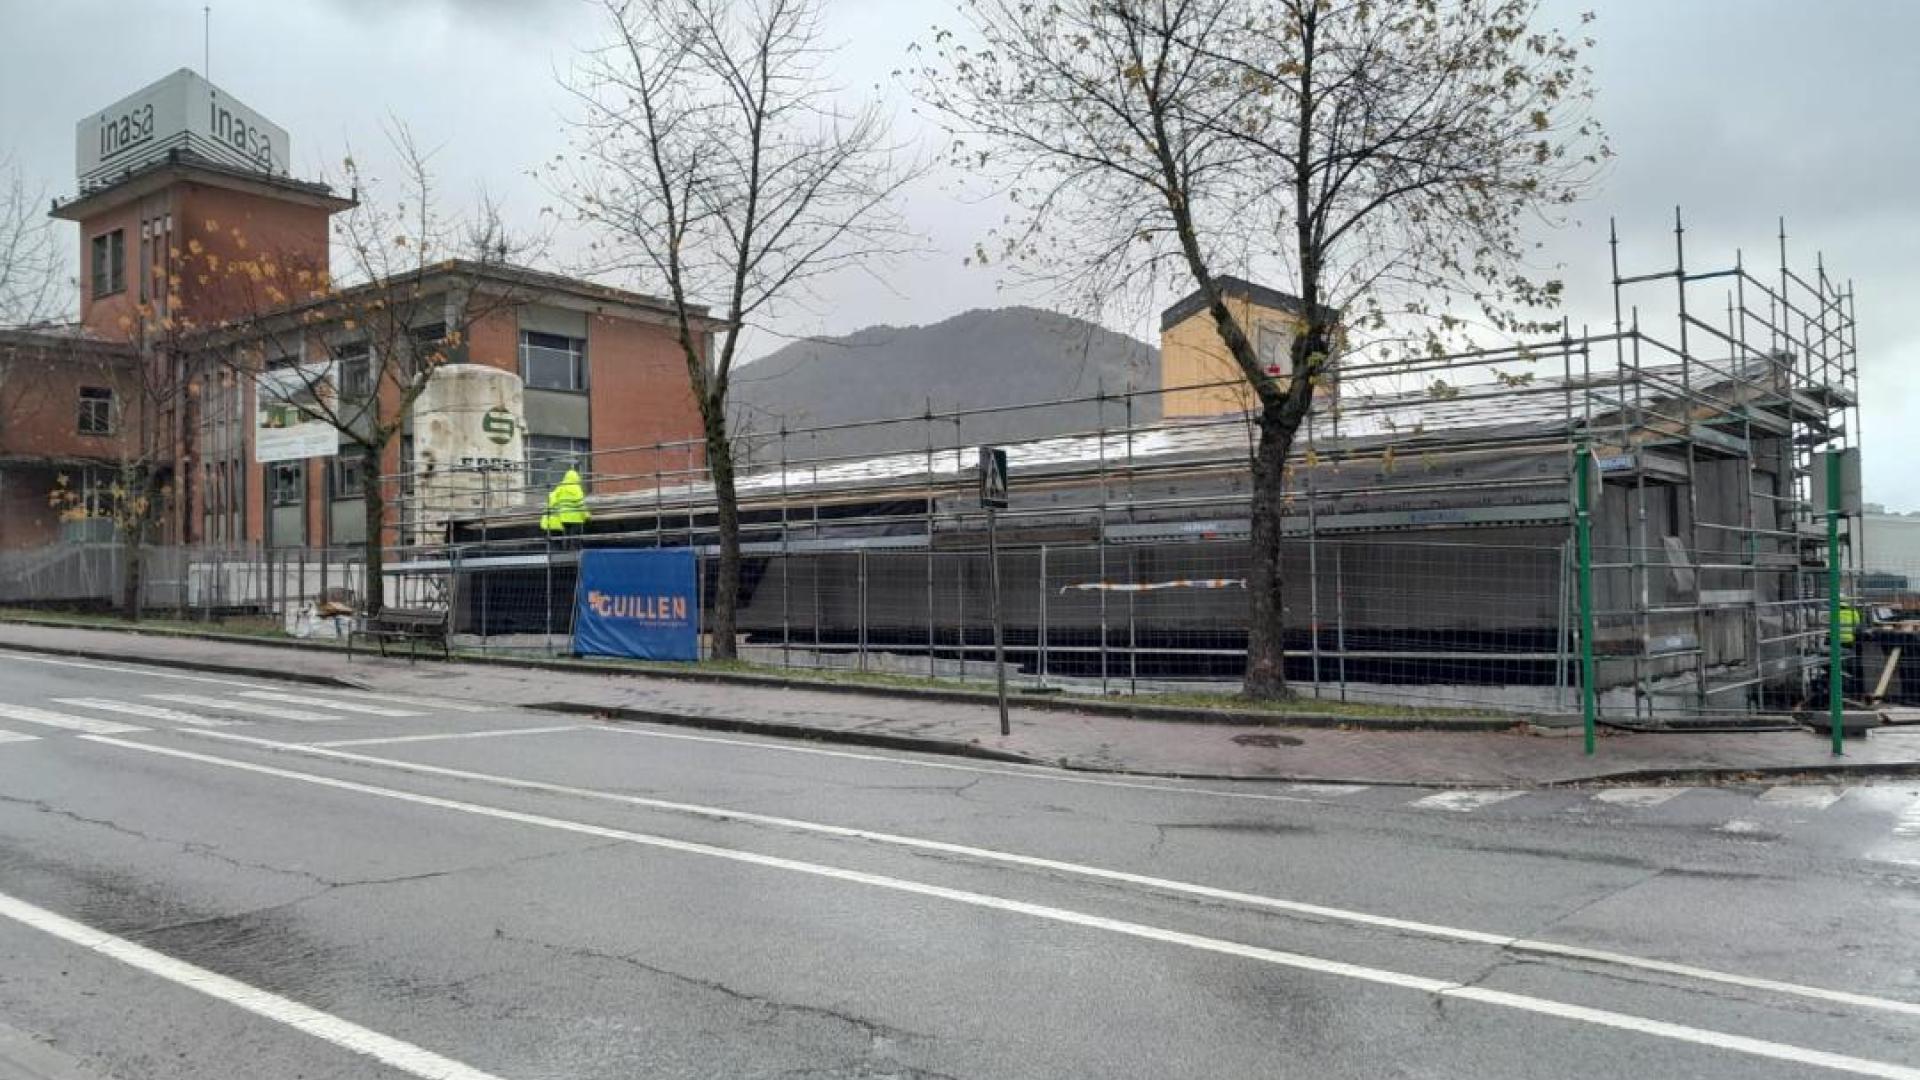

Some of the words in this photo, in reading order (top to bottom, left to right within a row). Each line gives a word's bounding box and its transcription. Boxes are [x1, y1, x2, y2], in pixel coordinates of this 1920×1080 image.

[100, 104, 154, 154] inasa
[211, 90, 271, 162] inasa
[599, 594, 687, 619] GUILLEN
